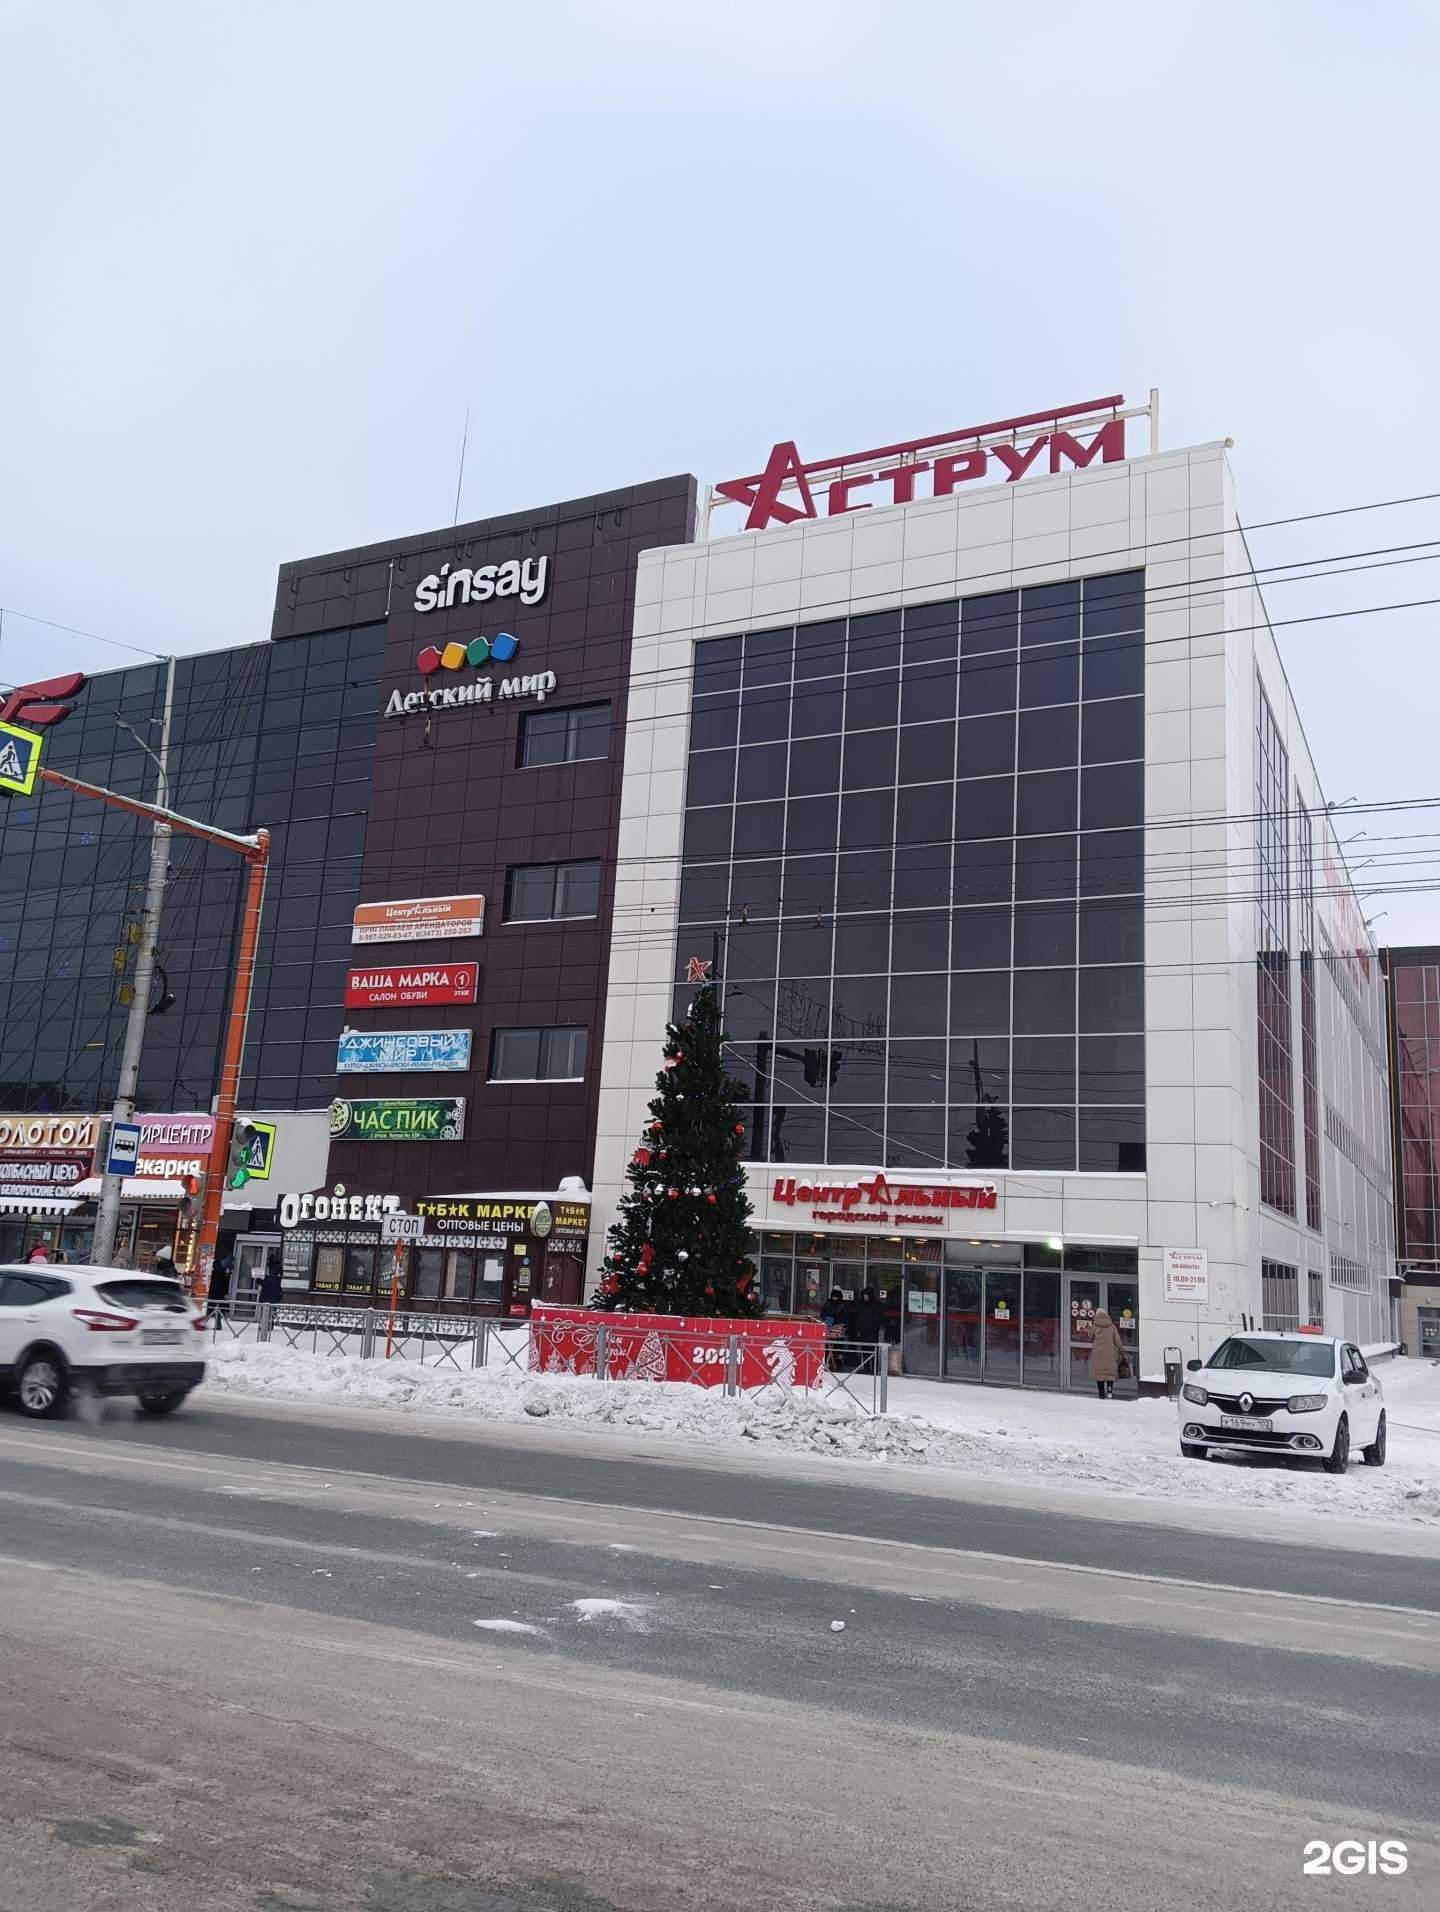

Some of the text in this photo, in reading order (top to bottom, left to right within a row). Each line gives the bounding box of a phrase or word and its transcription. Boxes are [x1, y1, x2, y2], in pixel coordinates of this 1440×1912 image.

[715, 397, 1125, 531] АСТРУМ
[414, 555, 548, 612] sinsay
[384, 670, 557, 718] Детский мир
[360, 919, 473, 934] ПРИГЛАШАЕМ АРЕНДАТОРОВ
[351, 971, 450, 989] ВАША МАРКА
[369, 991, 428, 1001] САЛОН ОБУВИ
[346, 1034, 456, 1049] ДЖИНСОВЫЙ
[379, 1048, 417, 1061] МИР
[354, 1110, 440, 1130] ЧАС ПИК
[0, 1162, 51, 1180] ОЛБАСНЫЙ
[389, 1218, 419, 1234] СТОП
[437, 1219, 490, 1231] ОПТОВЫЕ
[492, 1220, 524, 1233] ЦЕНЫ
[555, 1216, 588, 1226] МАРКЕТ
[812, 1210, 944, 1226] городской рынок
